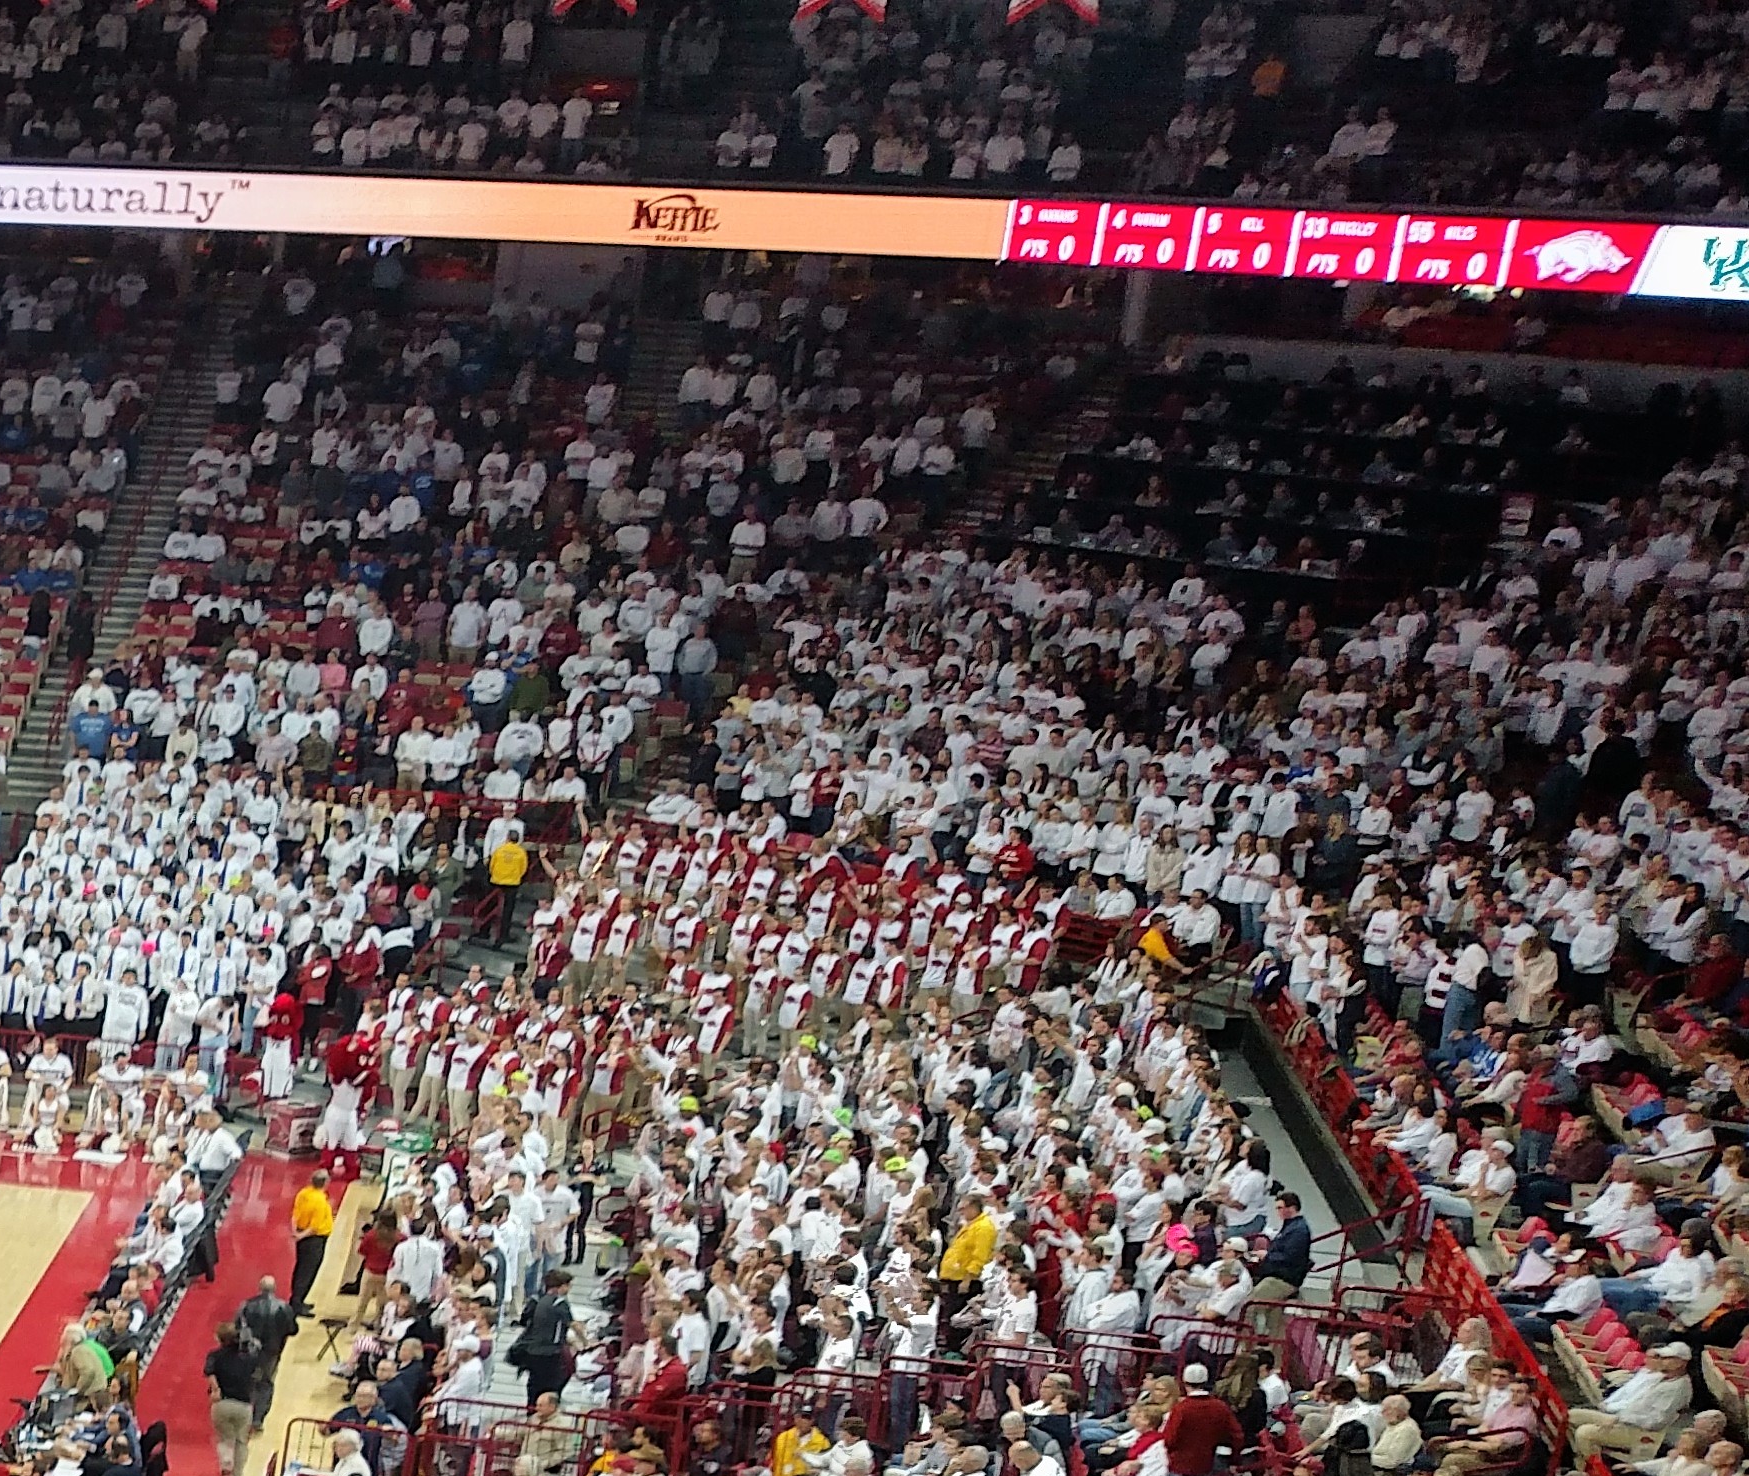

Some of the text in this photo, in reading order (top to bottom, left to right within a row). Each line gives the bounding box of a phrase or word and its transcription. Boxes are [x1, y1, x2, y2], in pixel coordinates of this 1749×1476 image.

[1020, 235, 1076, 261] PTS 0
[1114, 237, 1175, 264] PTS 0
[1207, 242, 1272, 270] PTS 0
[1306, 247, 1375, 275] PTS 0
[1415, 252, 1487, 280] PTS 0
